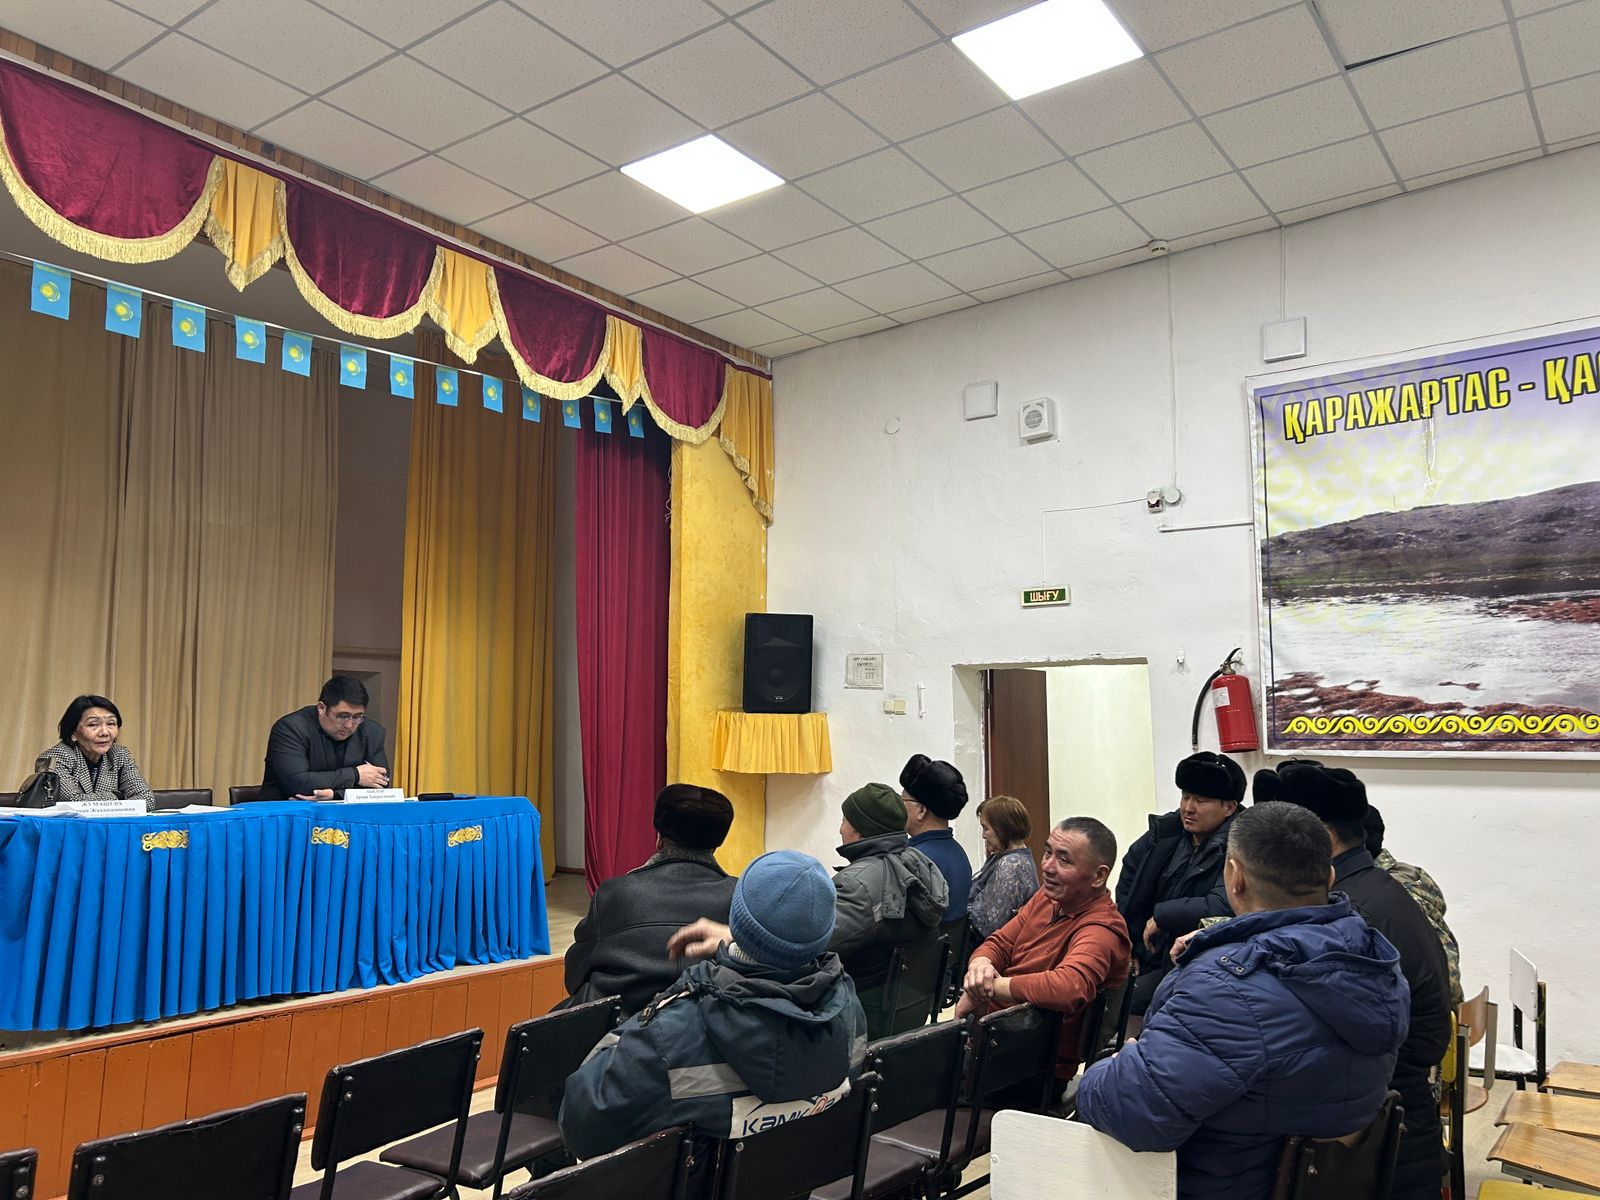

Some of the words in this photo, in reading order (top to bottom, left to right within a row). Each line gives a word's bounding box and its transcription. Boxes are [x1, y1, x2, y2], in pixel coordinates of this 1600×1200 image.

[1283, 368, 1510, 444] ҚАРАЖАРТАС
[1518, 382, 1535, 392] -
[1543, 350, 1600, 404] ҚА
[1030, 590, 1059, 602] ШЫҒУ
